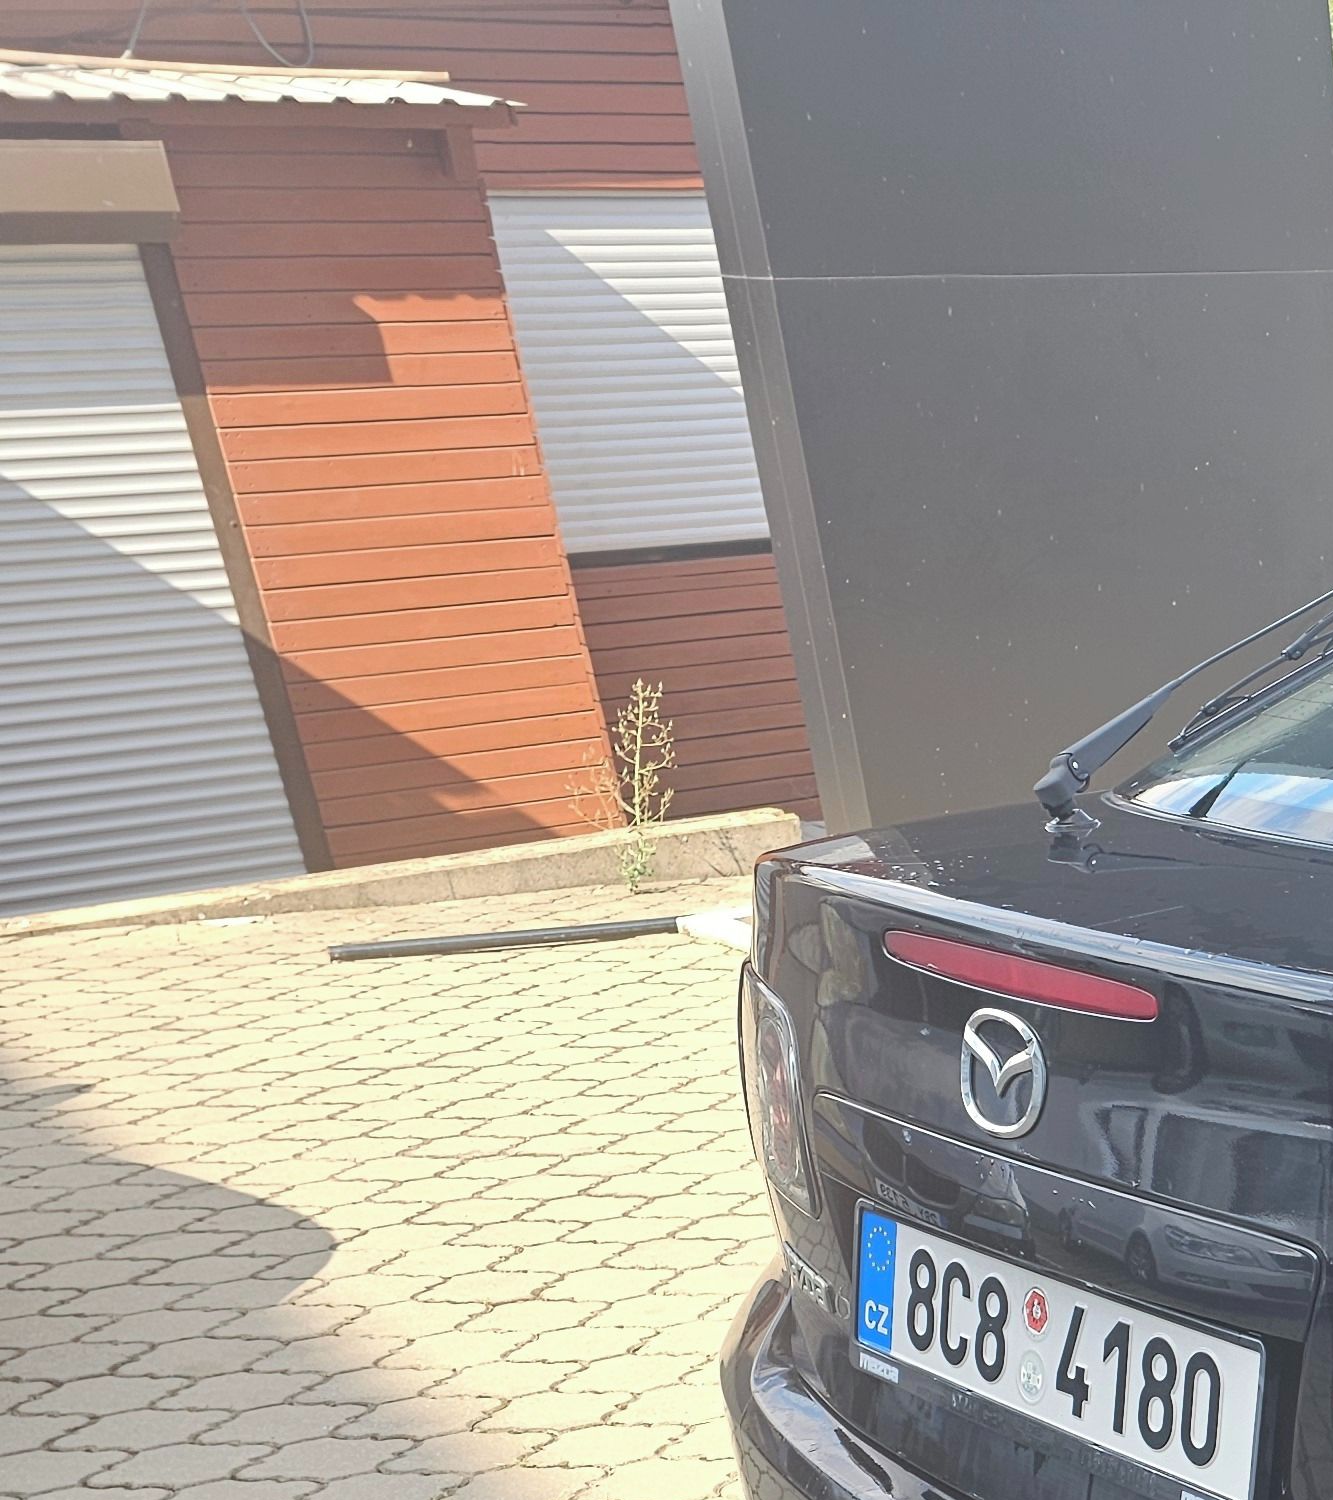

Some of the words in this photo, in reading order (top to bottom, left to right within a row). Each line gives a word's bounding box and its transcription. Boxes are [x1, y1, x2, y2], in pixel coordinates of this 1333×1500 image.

[864, 1299, 890, 1336] CZ
[906, 1248, 1009, 1383] 8C8
[1055, 1305, 1222, 1467] 4180
